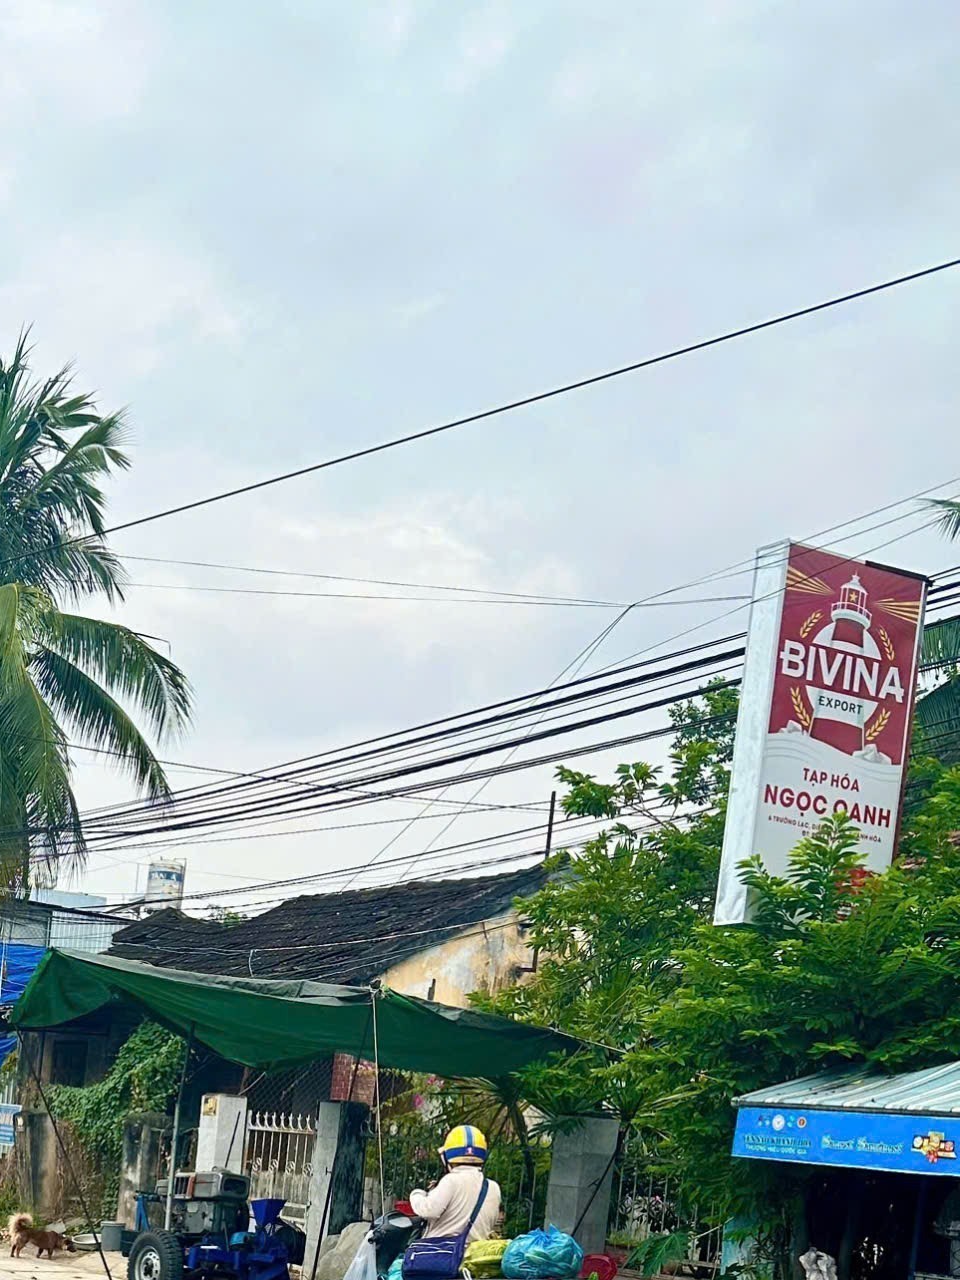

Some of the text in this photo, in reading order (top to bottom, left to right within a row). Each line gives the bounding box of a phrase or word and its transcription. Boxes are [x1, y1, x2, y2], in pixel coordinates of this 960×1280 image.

[780, 639, 904, 703] BIVINA
[818, 695, 863, 715] EXPORT
[803, 768, 859, 792] TẠP HÓA
[764, 783, 891, 828] NGỌC OANH
